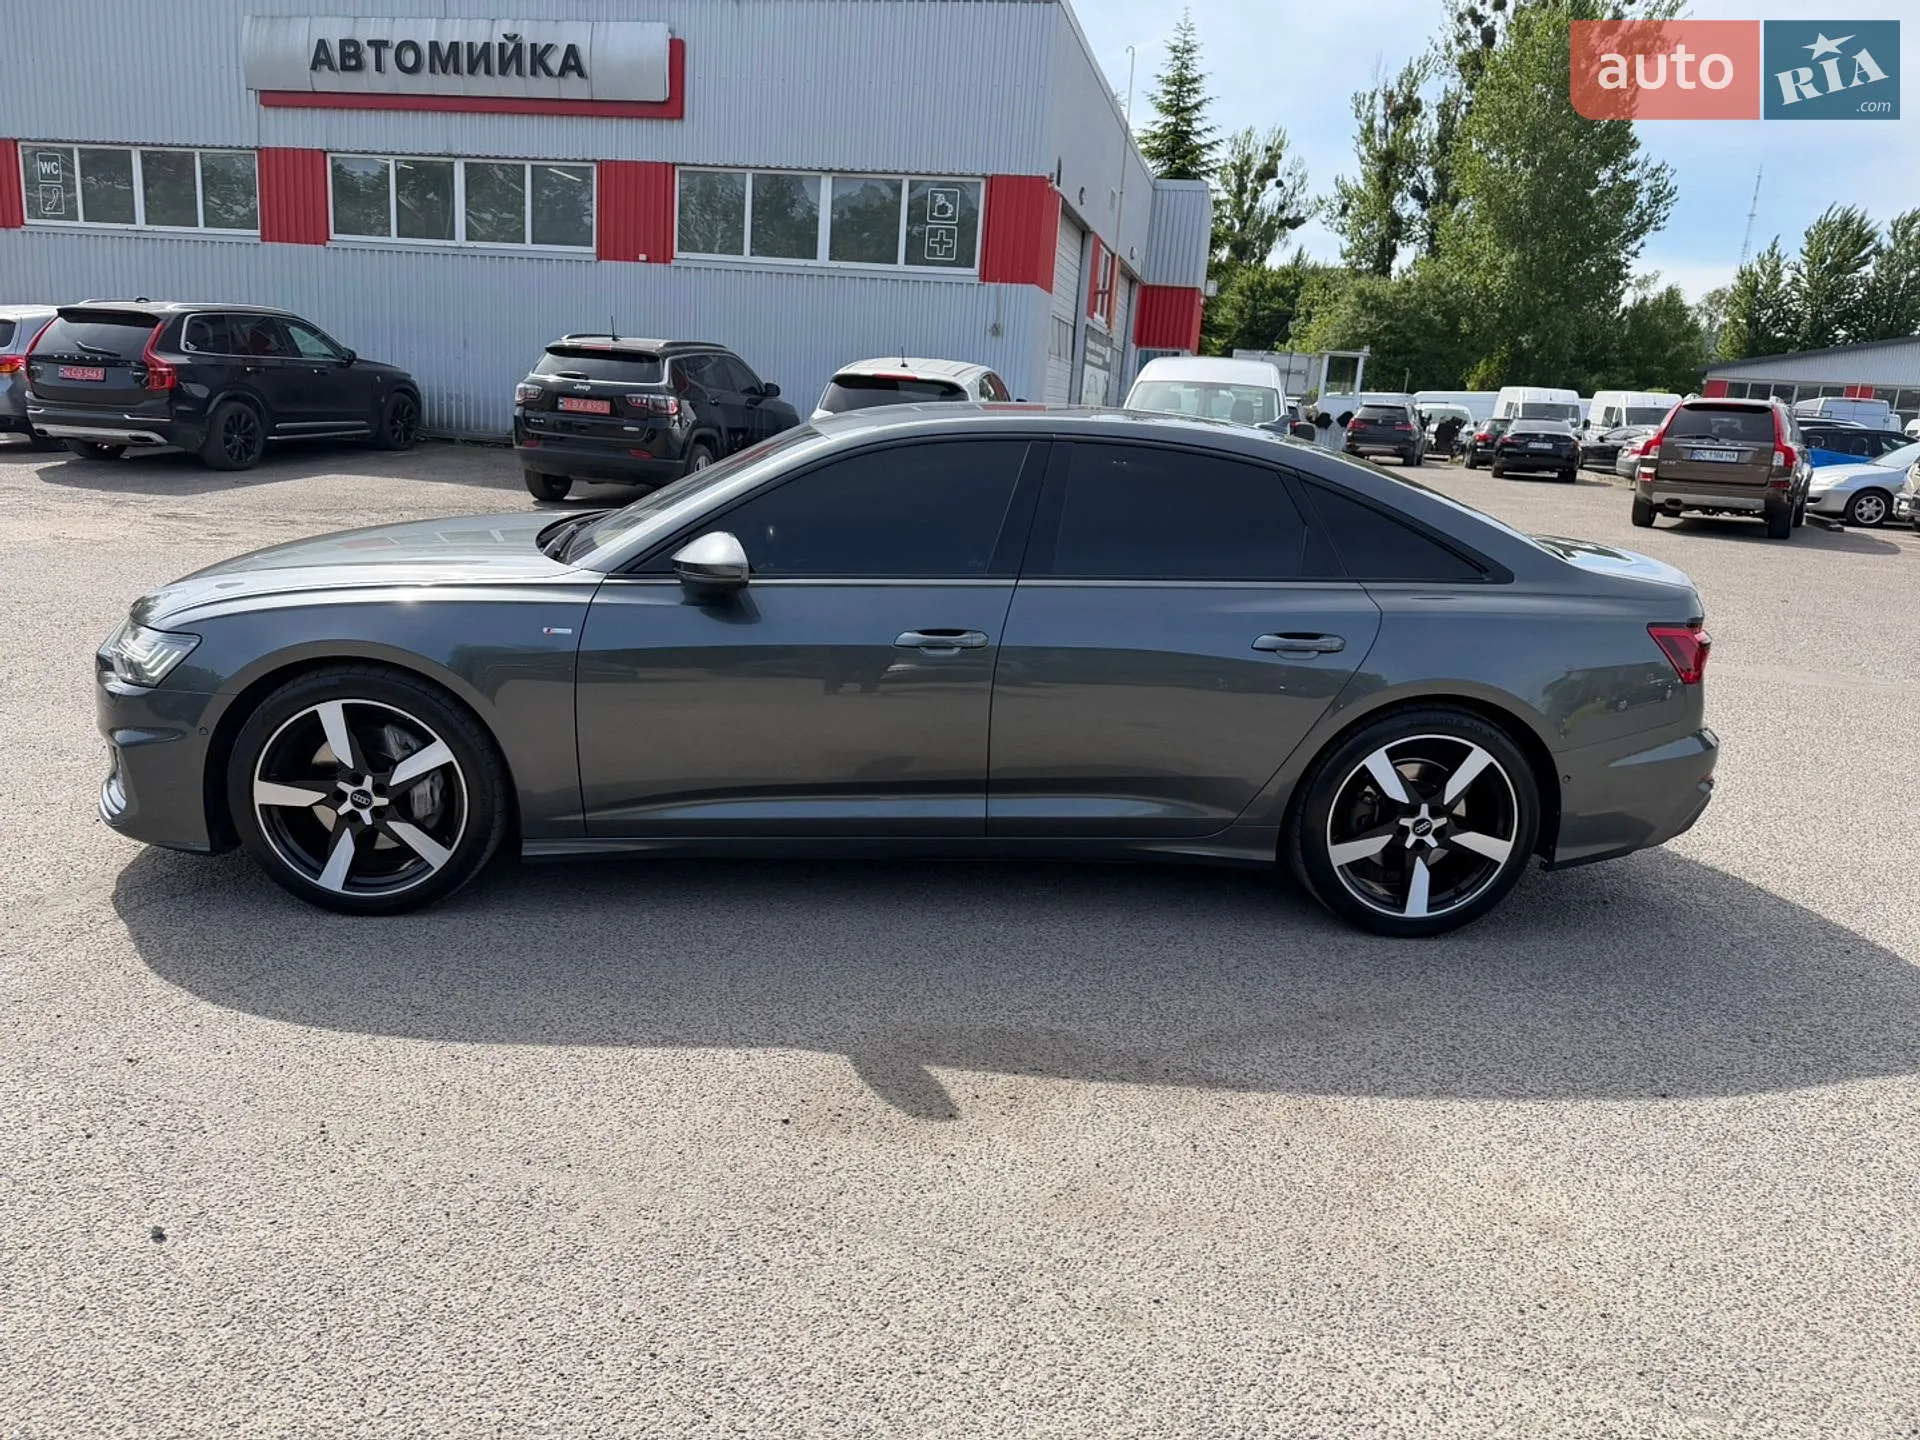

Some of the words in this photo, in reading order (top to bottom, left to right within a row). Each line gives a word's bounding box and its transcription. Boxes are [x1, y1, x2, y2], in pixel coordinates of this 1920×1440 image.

[310, 33, 588, 80] АВТОМИЙКА
[40, 161, 59, 175] WC
[574, 384, 591, 392] Jeep
